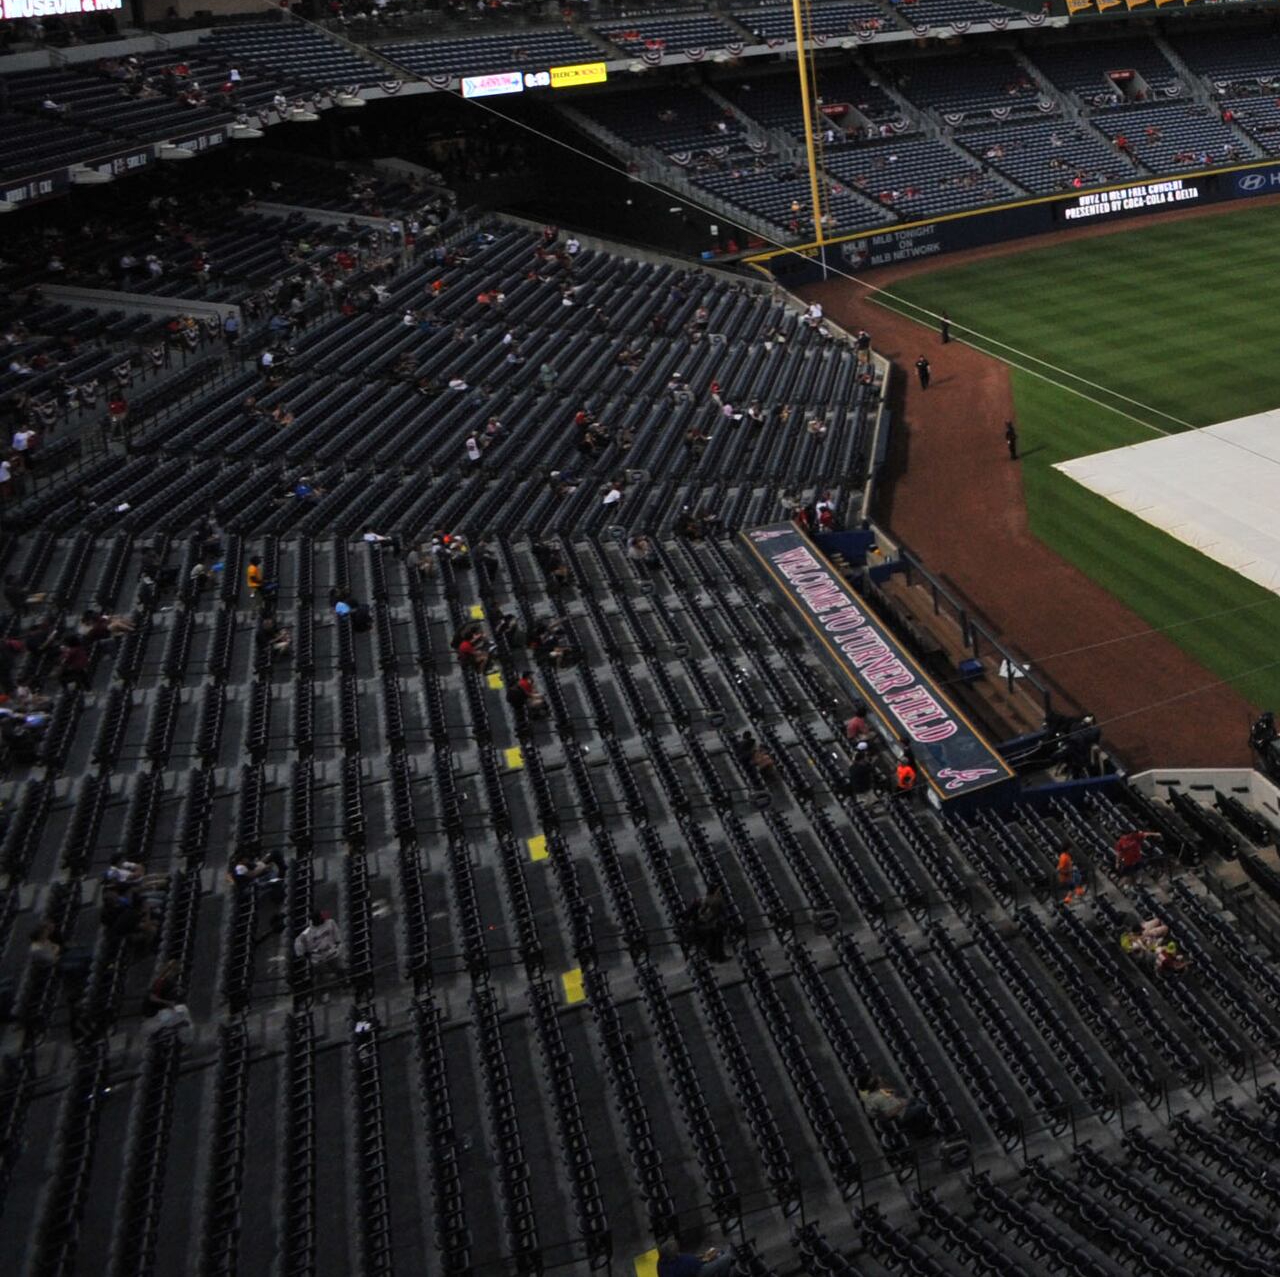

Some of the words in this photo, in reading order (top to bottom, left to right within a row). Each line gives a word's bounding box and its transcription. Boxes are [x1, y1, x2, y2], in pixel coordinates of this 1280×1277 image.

[1148, 180, 1183, 194] CONCERT
[1065, 203, 1110, 219] PRESENTED
[1111, 201, 1122, 212] BY
[1123, 192, 1166, 209] COCA-COLA
[1176, 187, 1198, 201] DELTA
[842, 240, 867, 252] MLB
[872, 235, 893, 245] MLB
[895, 225, 936, 240] TONIGHT
[899, 239, 913, 248] ON
[871, 254, 891, 265] MLB
[893, 243, 941, 260] NETWORK
[771, 545, 852, 613] WELCOME
[819, 605, 865, 632] TO
[834, 625, 915, 695] TURNER
[882, 684, 958, 743] FIELD
